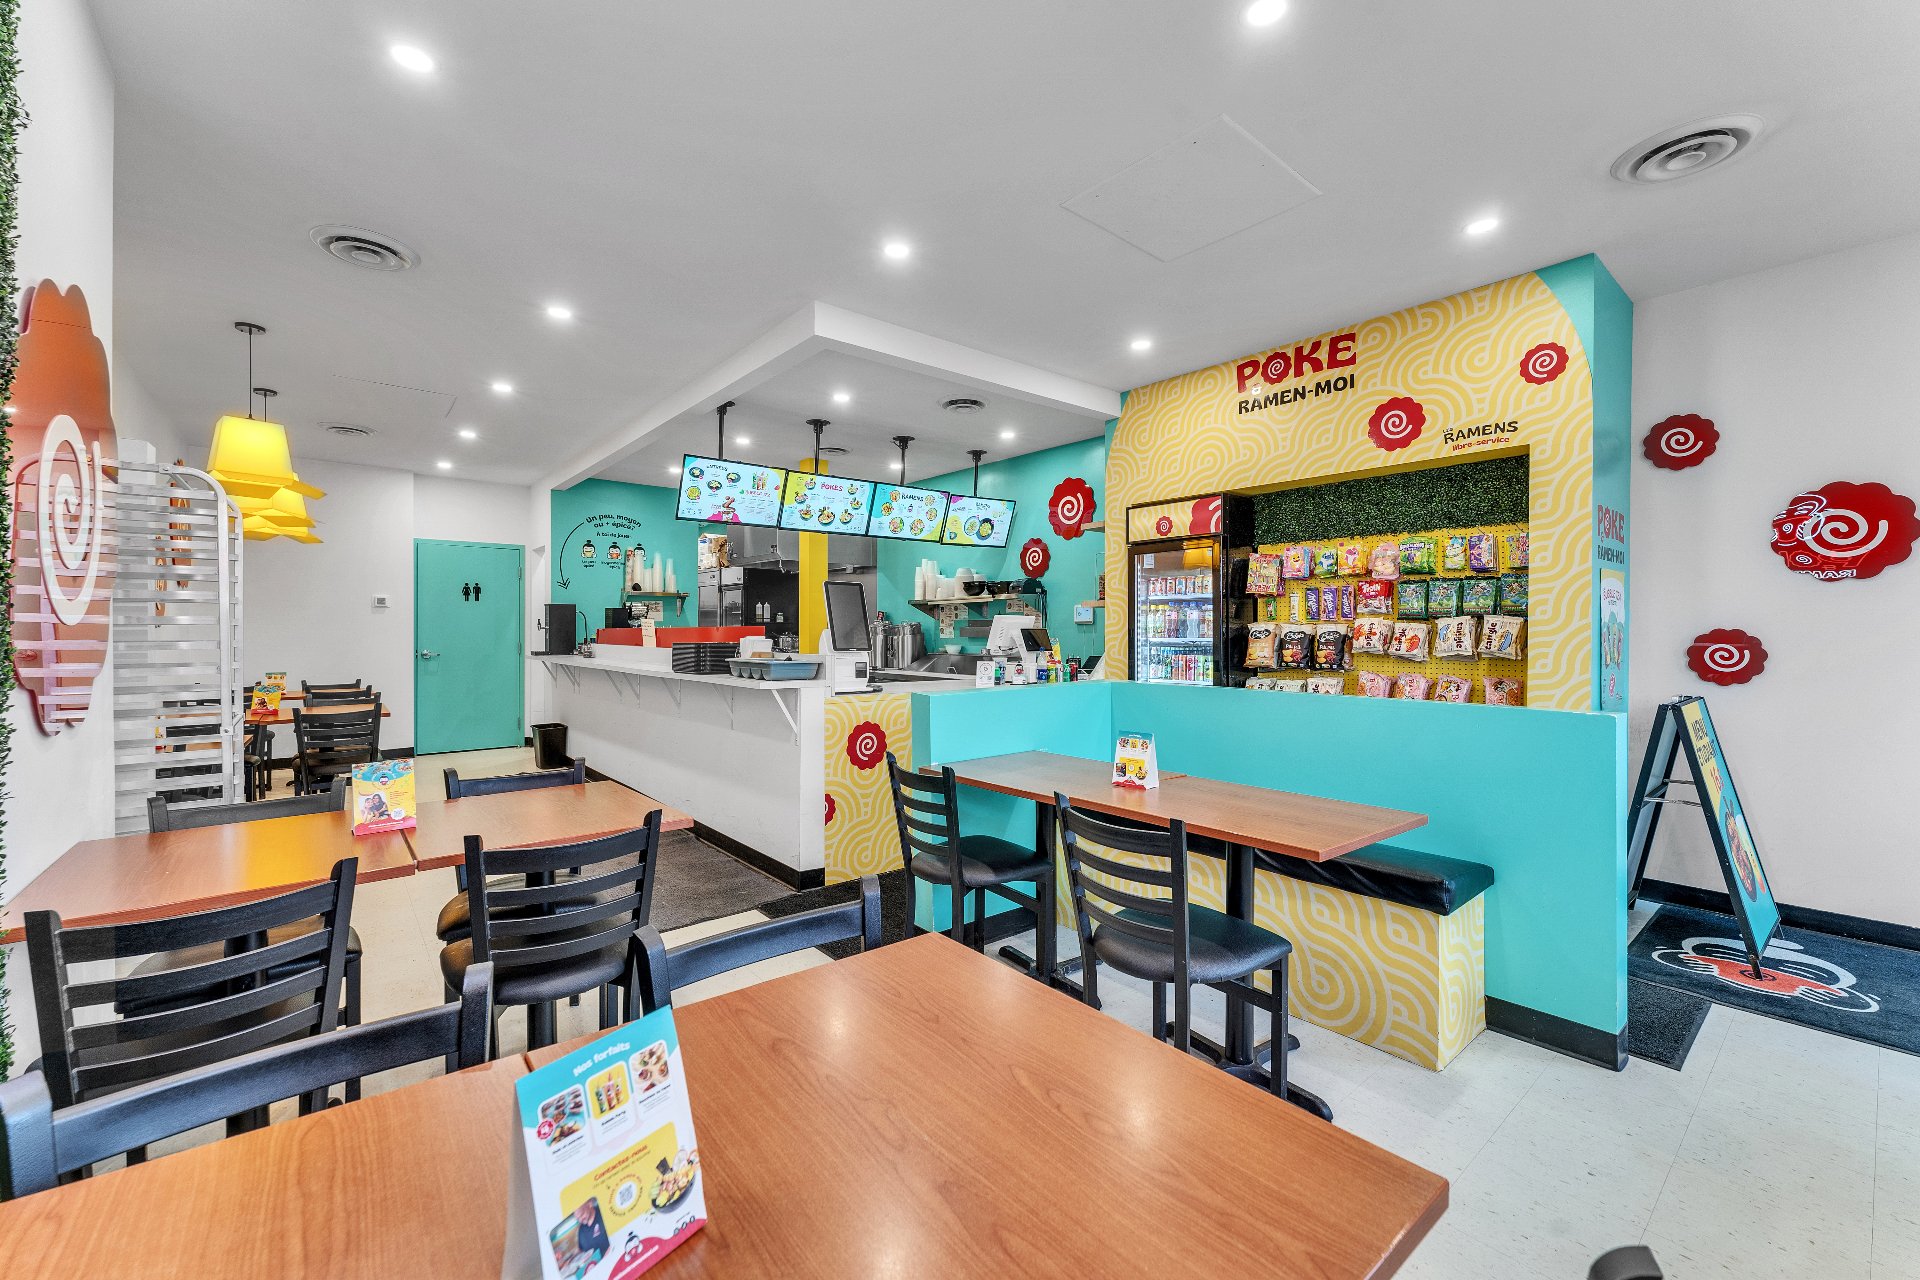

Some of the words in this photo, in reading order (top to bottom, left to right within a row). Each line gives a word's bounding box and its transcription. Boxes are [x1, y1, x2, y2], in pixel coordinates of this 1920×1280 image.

[1237, 332, 1356, 393] POKE
[1238, 374, 1355, 414] RAMEN-MOI
[1444, 421, 1518, 444] RAMENS
